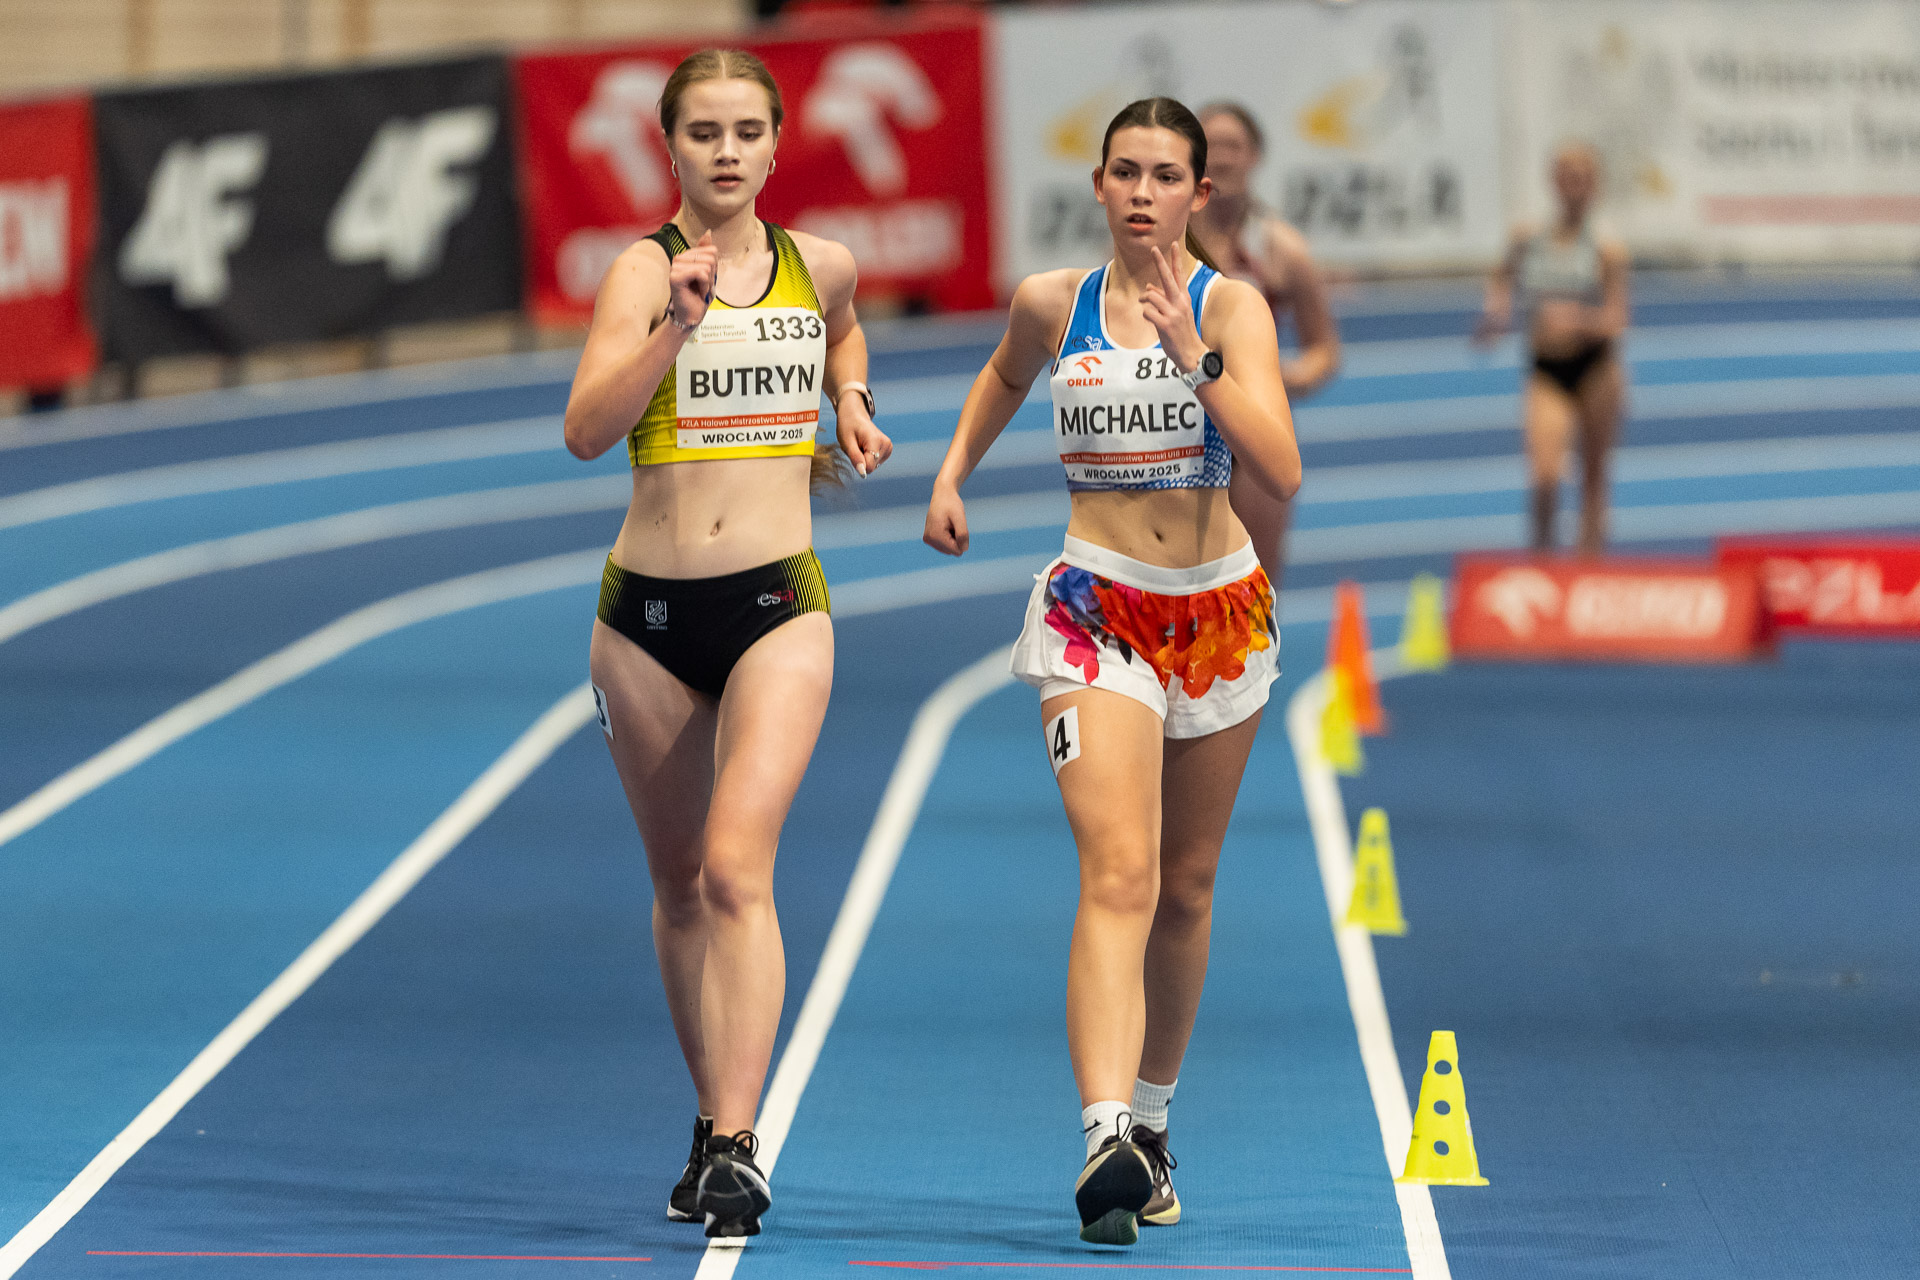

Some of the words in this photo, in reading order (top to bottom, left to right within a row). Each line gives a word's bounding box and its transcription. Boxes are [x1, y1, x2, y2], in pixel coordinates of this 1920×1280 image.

[326, 104, 498, 281] 4F
[118, 132, 269, 308] 4F
[754, 316, 822, 342] 1333
[690, 364, 815, 399] BUTRYN
[1067, 378, 1103, 387] ORLEN
[681, 420, 699, 428] PZLA
[700, 418, 729, 428] Halowe
[730, 416, 775, 426] Mistrzostwa
[776, 414, 797, 424] Polski
[1060, 402, 1197, 436] MICHALEC
[702, 431, 777, 444] WROCŁAW
[780, 428, 803, 440] 2025
[1102, 454, 1143, 463] Mistrzostwa
[1144, 452, 1167, 461] Polski
[1167, 450, 1180, 459] U18
[1186, 448, 1200, 456] U20
[1084, 468, 1145, 480] WROCŁAW
[1148, 464, 1181, 478] 2025
[1762, 557, 1920, 622] PZL
[1053, 716, 1071, 761] 4
